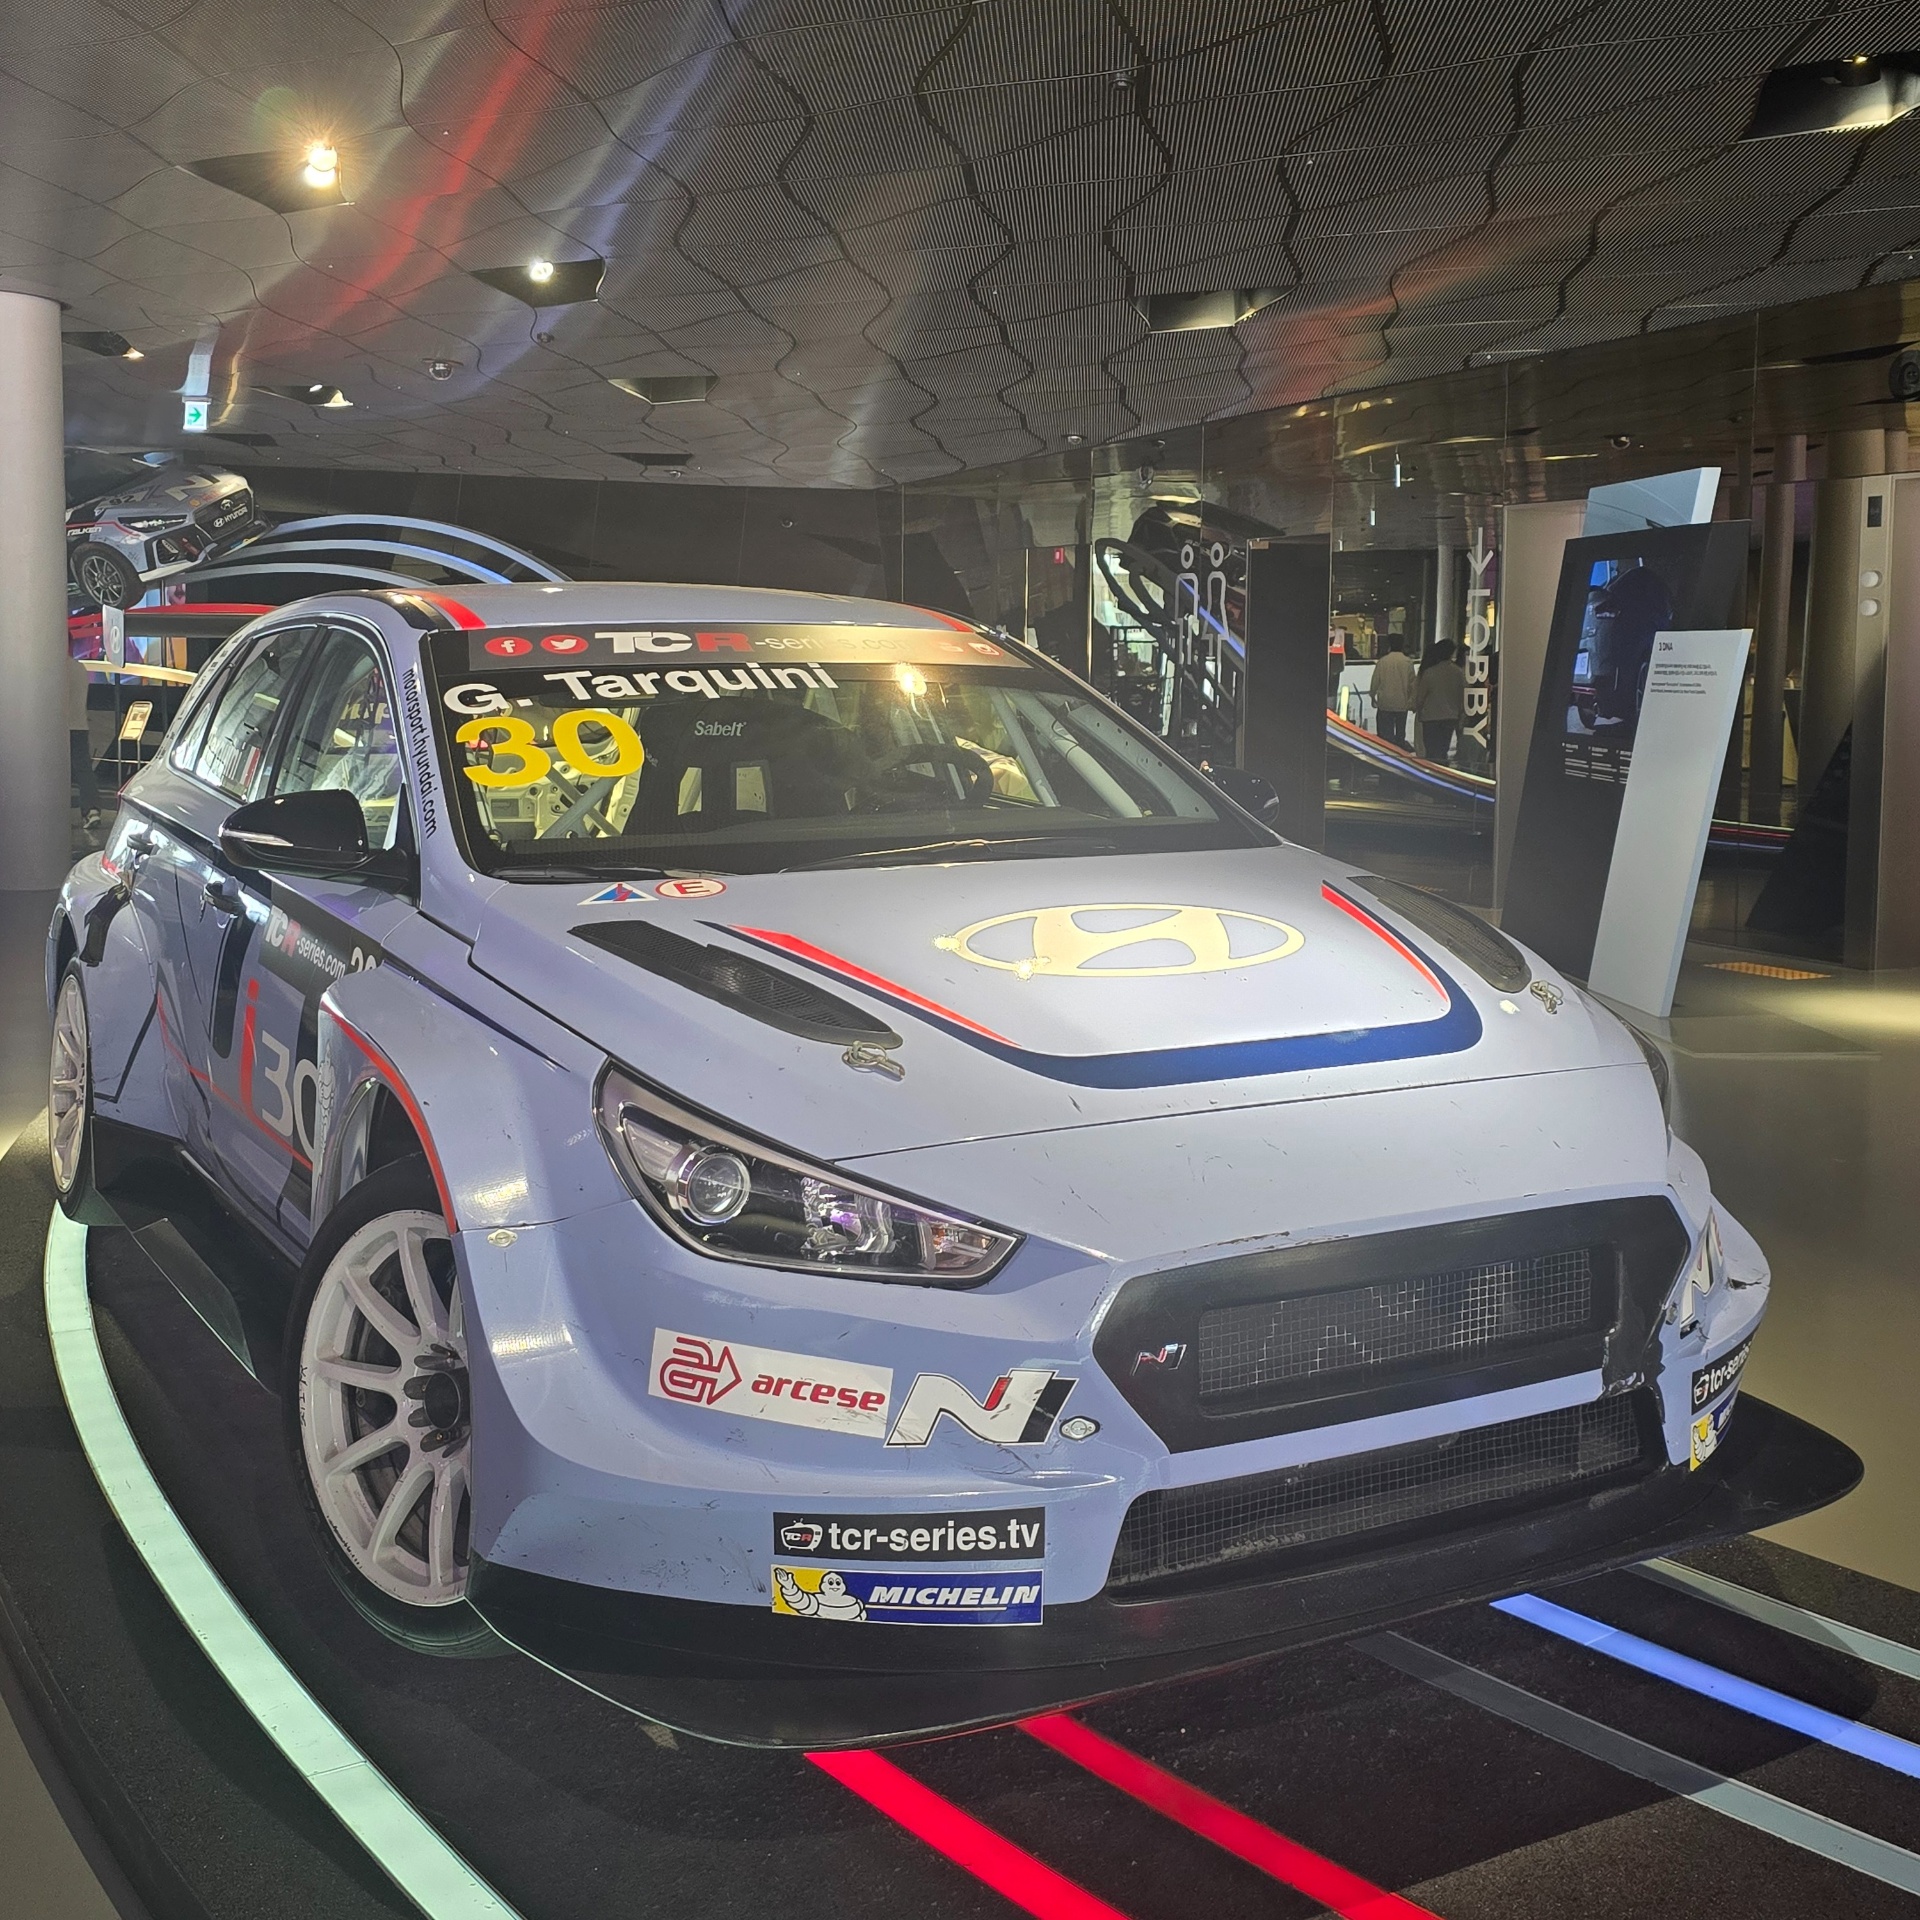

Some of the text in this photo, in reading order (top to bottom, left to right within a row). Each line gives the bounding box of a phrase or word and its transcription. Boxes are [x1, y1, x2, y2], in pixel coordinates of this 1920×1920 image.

[224, 506, 248, 523] HYUNDAI
[443, 661, 839, 715] G. Tarquini
[1463, 588, 1491, 749] LOBBY
[456, 709, 645, 788] 30
[694, 720, 745, 738] Sabelt
[402, 668, 438, 839] motorsport.hyundai.com
[239, 977, 320, 1164] i30
[750, 1373, 886, 1413] arcese
[784, 1531, 812, 1542] TCR
[828, 1518, 1041, 1551] tcr-series.tv
[868, 1585, 1041, 1606] MICHELIN
